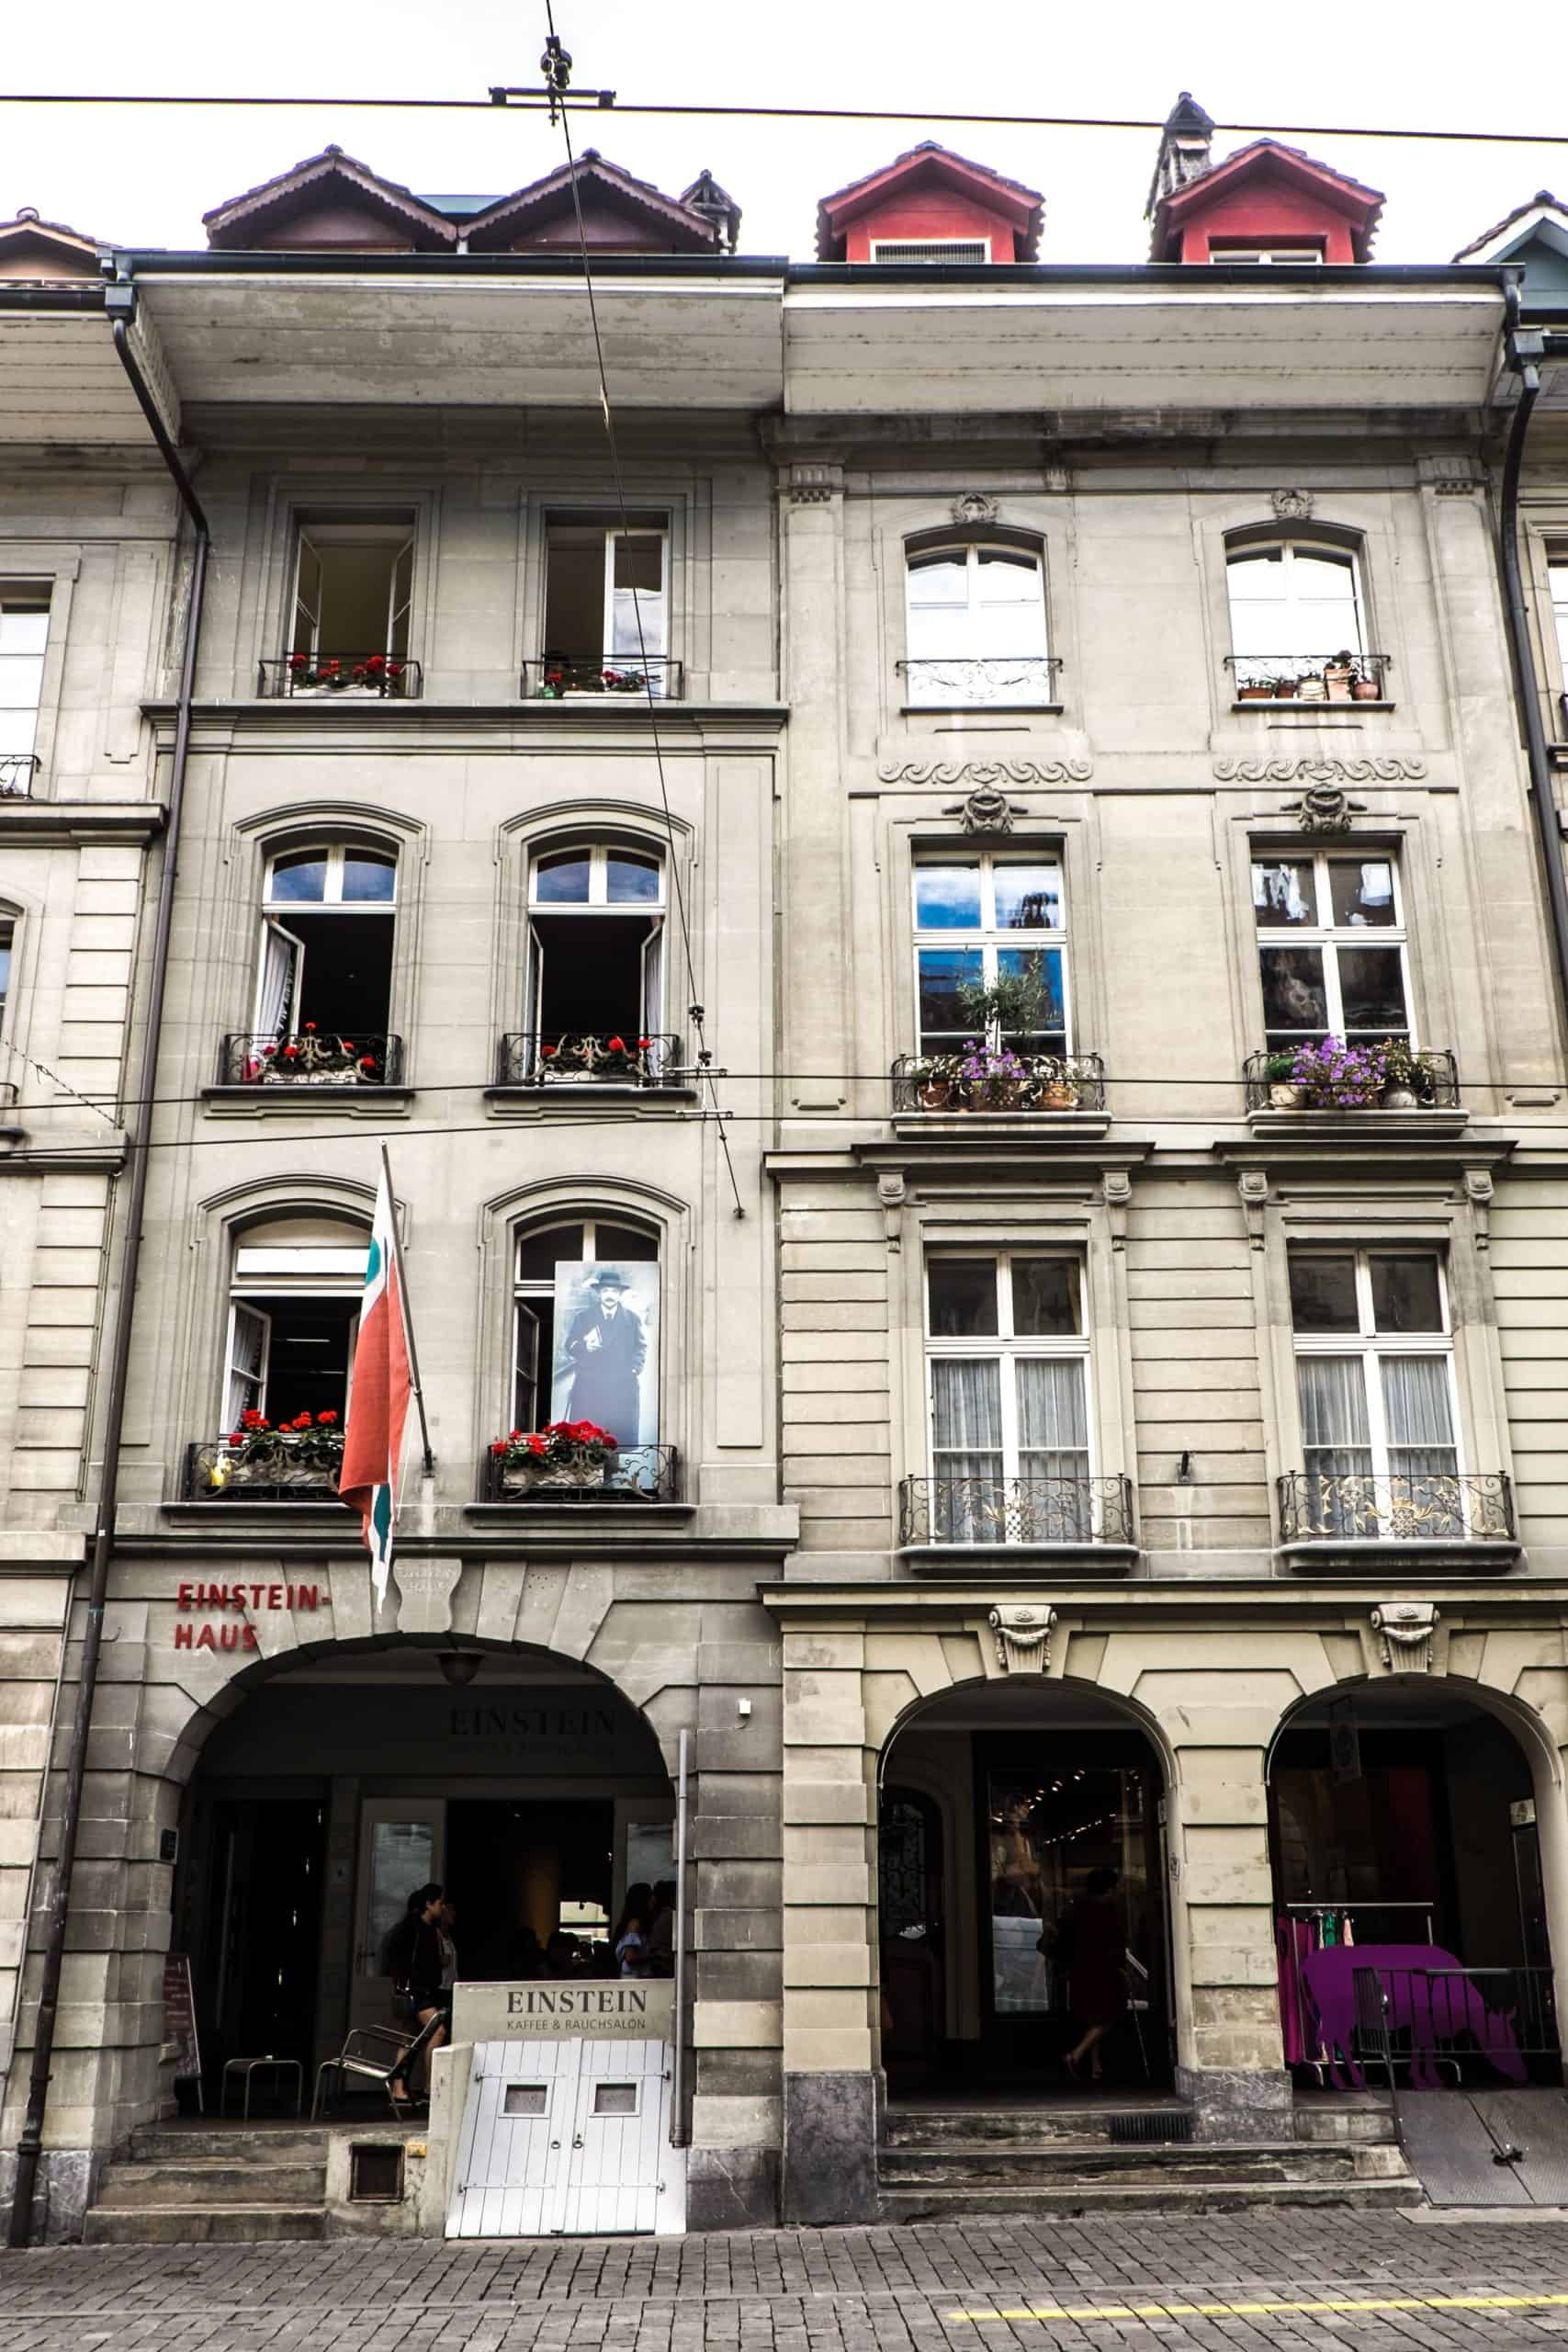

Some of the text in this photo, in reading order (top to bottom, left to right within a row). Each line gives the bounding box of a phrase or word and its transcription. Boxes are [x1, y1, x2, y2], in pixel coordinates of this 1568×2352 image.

[177, 1584, 332, 1611] EINSTEIN-
[175, 1623, 256, 1650] HAUS
[449, 1707, 618, 1736] EINSTEIN
[507, 1990, 647, 2013] EINSTEIN
[507, 2018, 647, 2030] KAFFEE & RAUCHSALON
